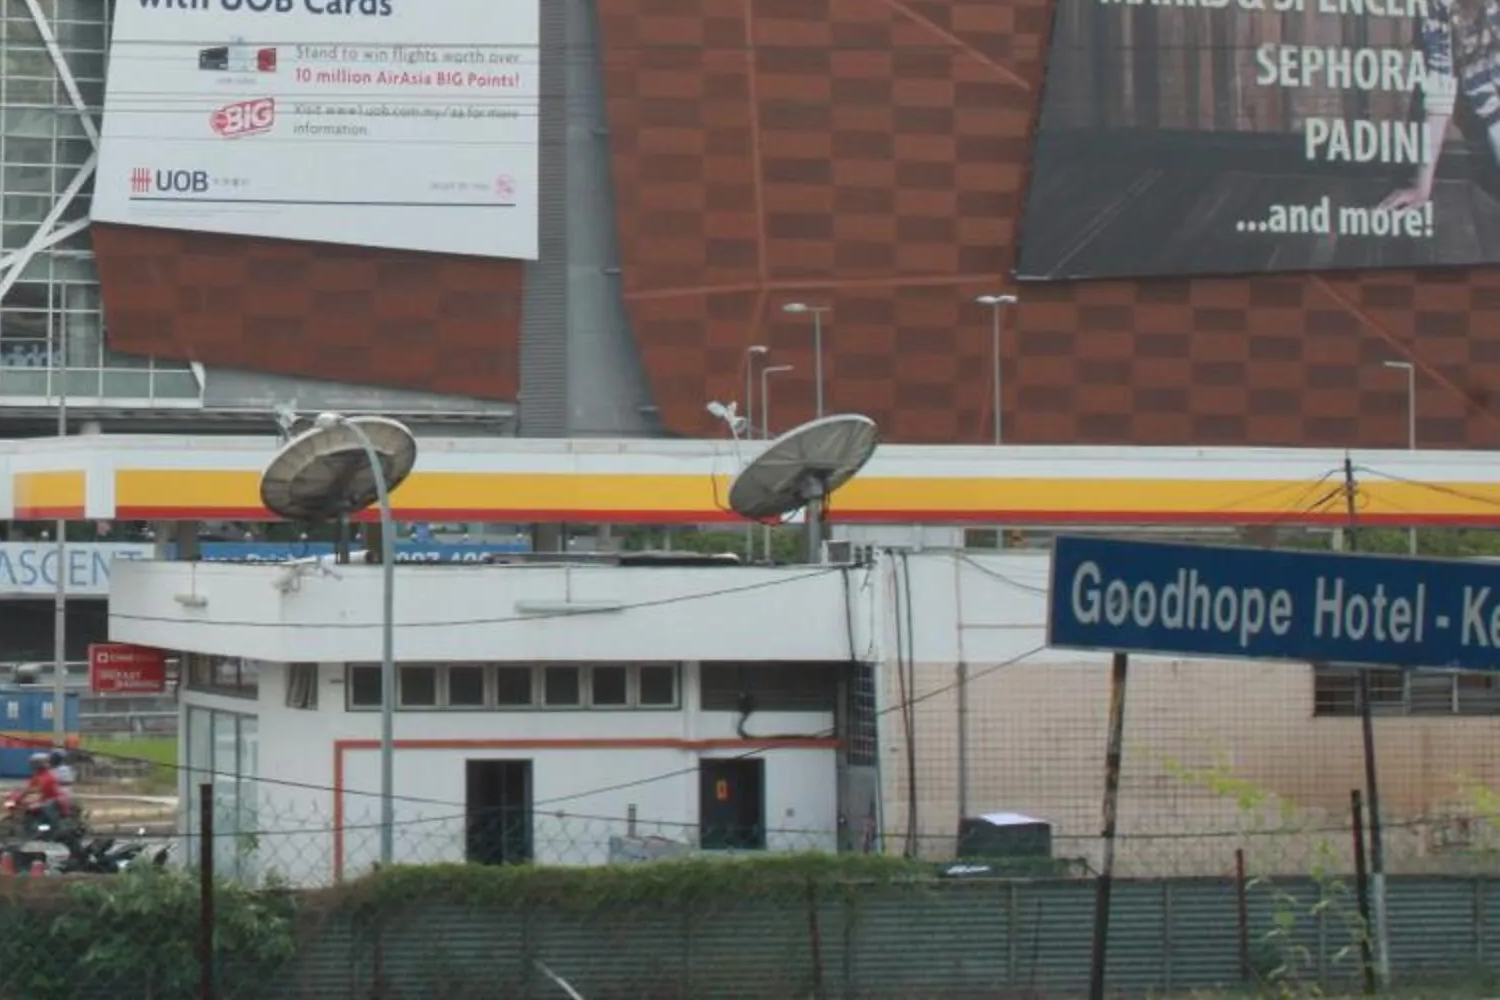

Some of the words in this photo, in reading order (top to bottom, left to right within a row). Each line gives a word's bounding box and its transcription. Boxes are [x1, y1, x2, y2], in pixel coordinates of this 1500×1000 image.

[296, 44, 337, 60] Stand
[342, 46, 359, 61] to
[364, 48, 388, 61] win
[393, 46, 437, 65] flights
[443, 49, 485, 63] worth
[489, 52, 519, 64] over
[1256, 43, 1429, 92] SEPHORA
[296, 68, 311, 83] 10
[316, 69, 371, 84] million
[376, 71, 431, 85] AirAsia
[437, 72, 463, 86] BIG
[468, 73, 520, 88] Points!
[225, 101, 273, 131] BIG
[1305, 117, 1431, 164] PADINI
[156, 170, 208, 192] UOB
[1340, 203, 1434, 237] more!
[1071, 560, 1292, 648] Goodhope
[1314, 576, 1425, 642] Hotel
